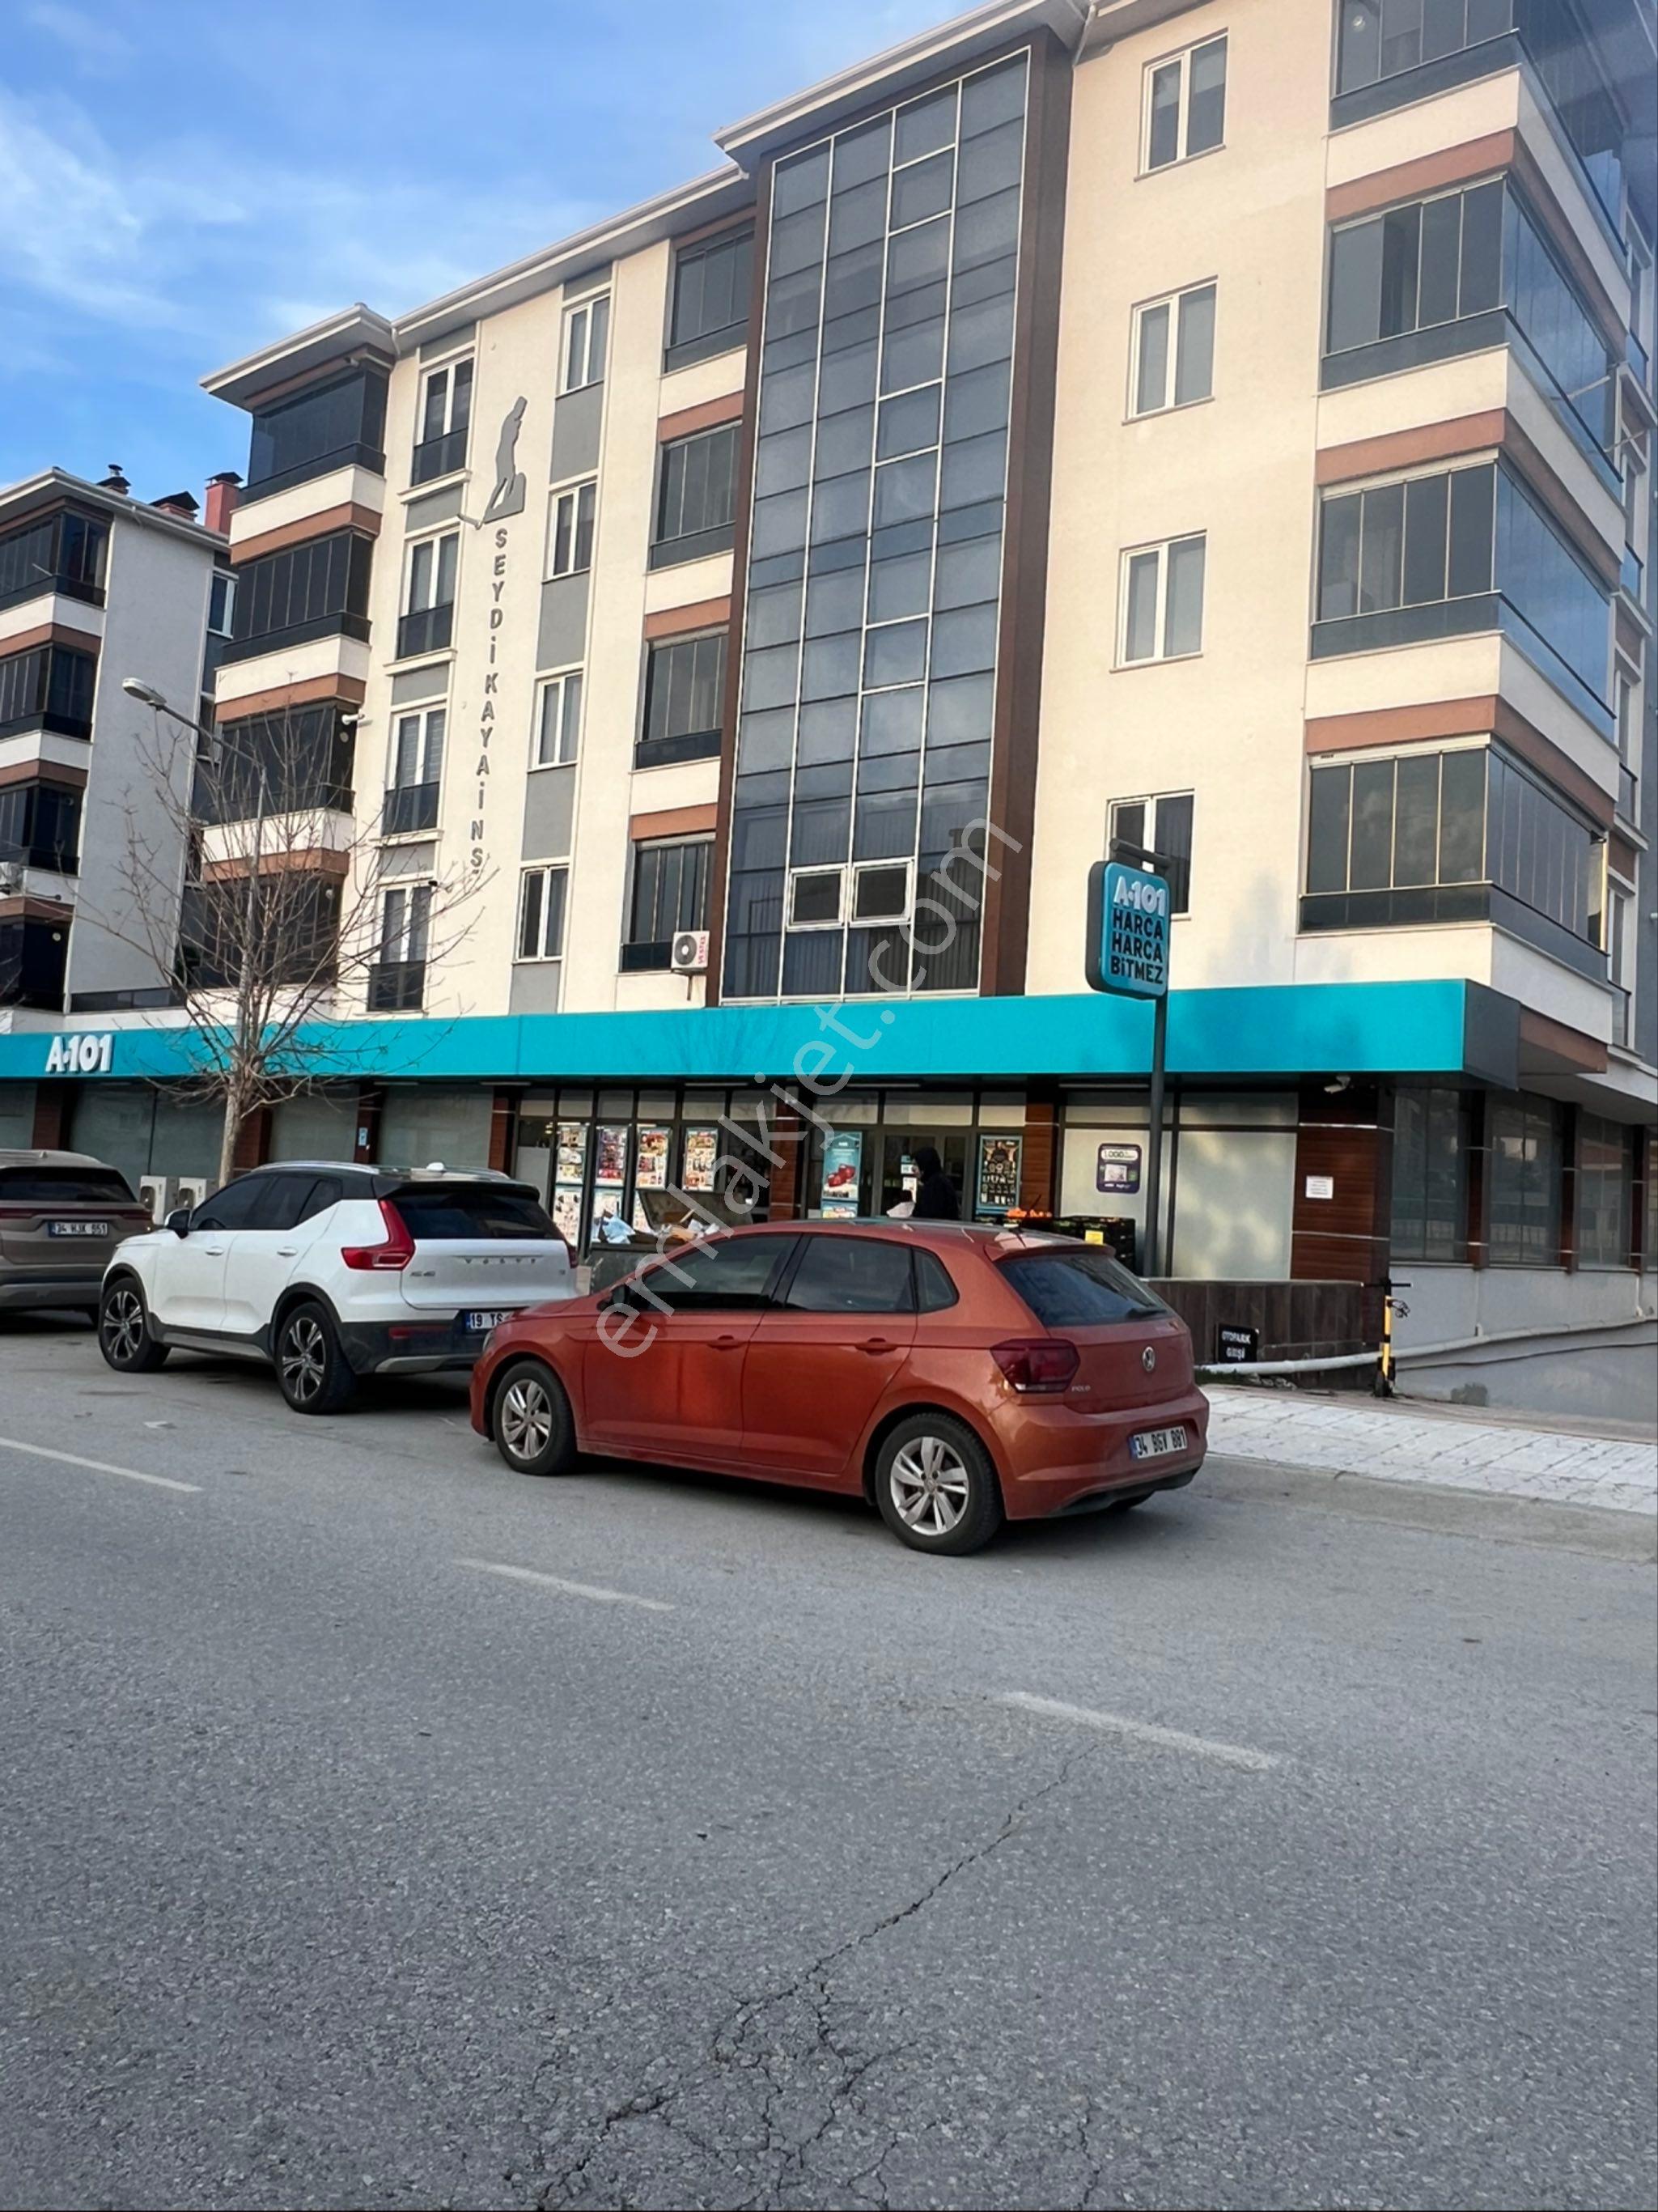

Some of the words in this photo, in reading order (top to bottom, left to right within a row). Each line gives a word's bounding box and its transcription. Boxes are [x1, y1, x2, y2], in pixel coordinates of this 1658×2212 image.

[1113, 909, 1164, 940] HARCA
[1112, 932, 1164, 963] HARCA
[472, 1313, 483, 1327] 19
